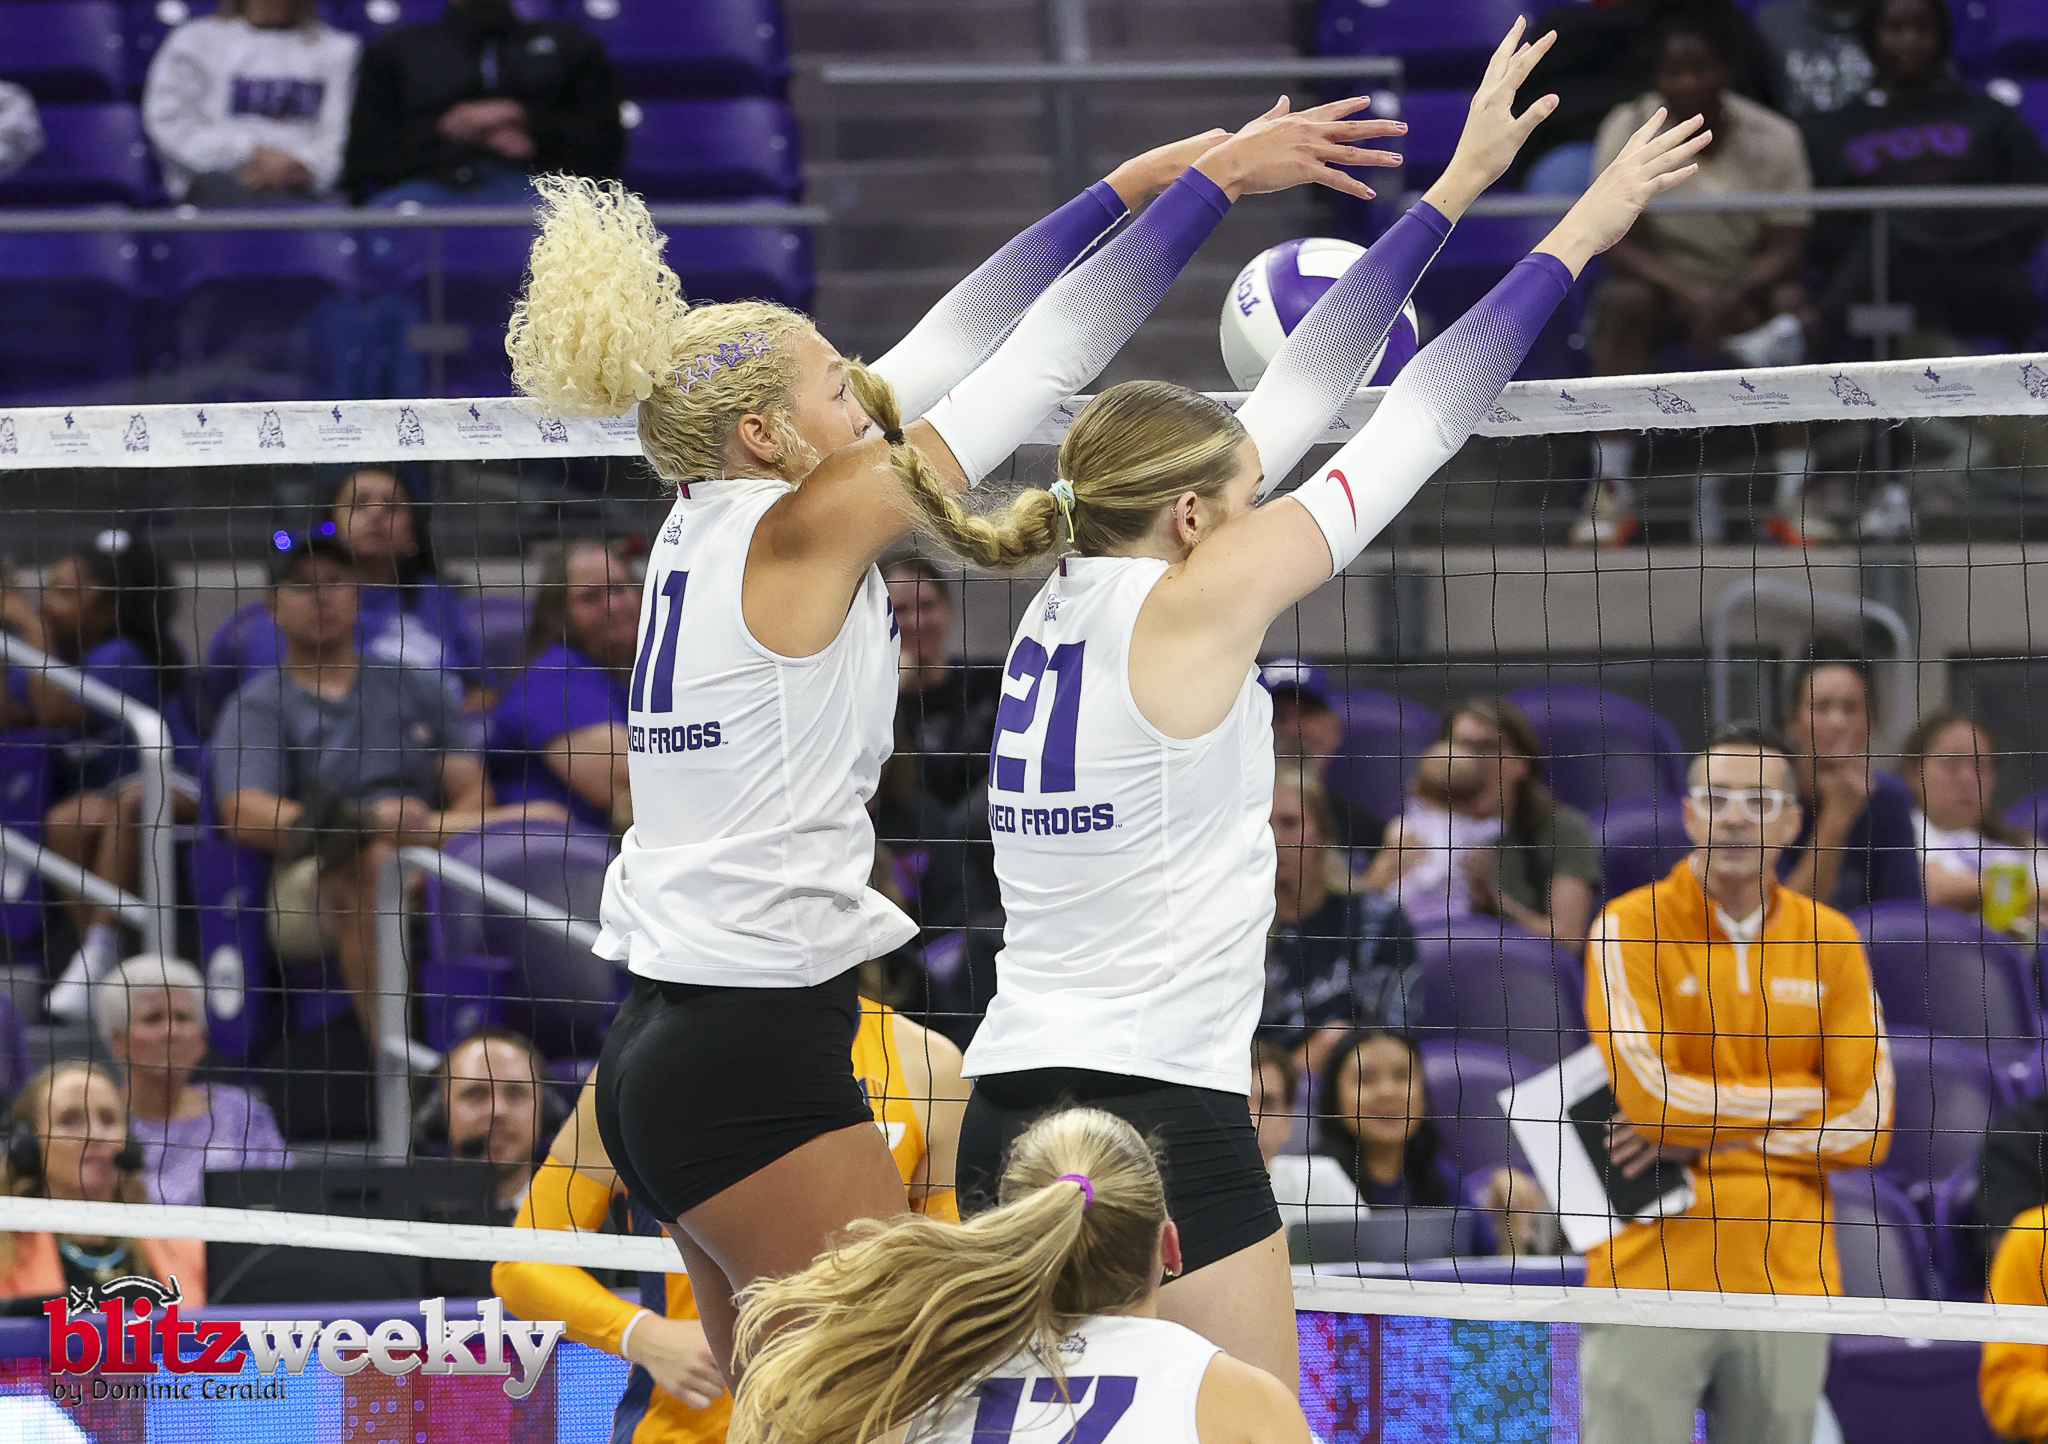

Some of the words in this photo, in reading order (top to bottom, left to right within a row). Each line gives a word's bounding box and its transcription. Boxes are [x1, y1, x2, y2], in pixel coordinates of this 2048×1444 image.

[1238, 268, 1261, 317] TCU
[631, 568, 690, 713] 11
[649, 721, 721, 754] FROGS
[988, 635, 1086, 793] 21
[1022, 802, 1114, 835] FROGS
